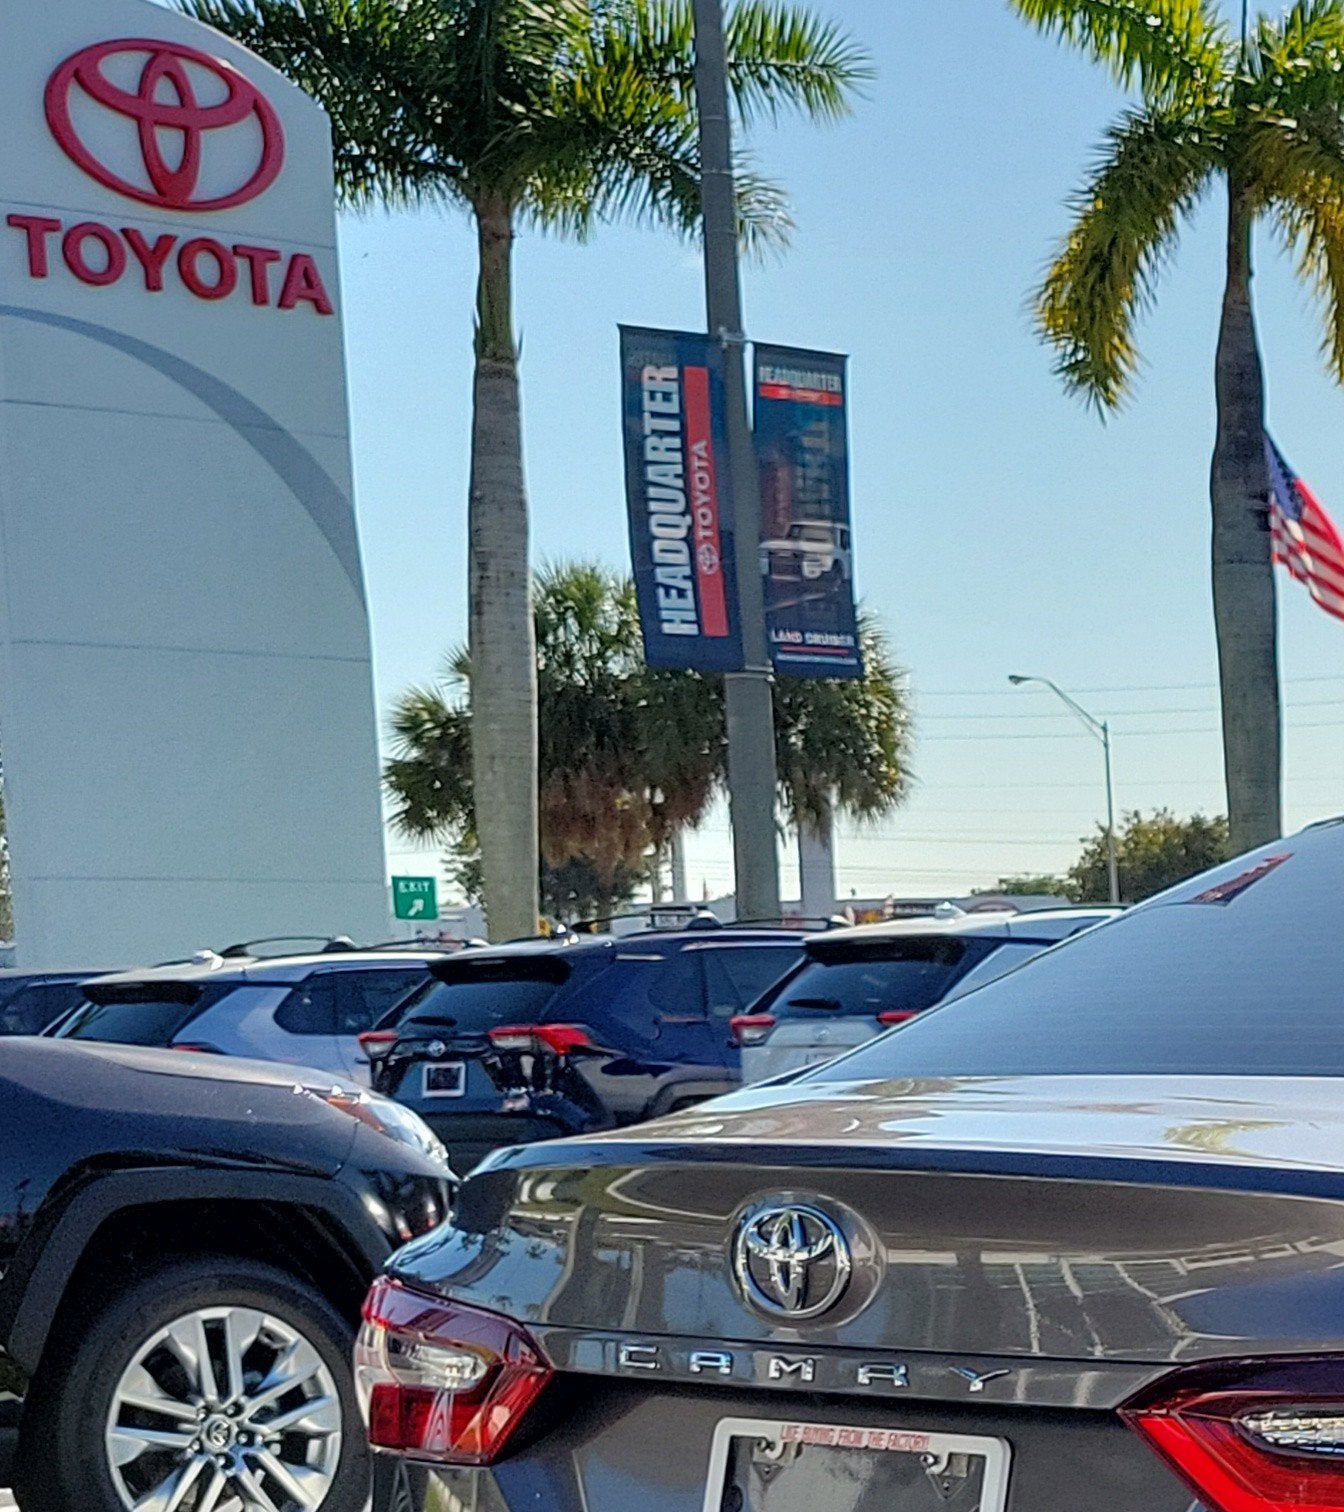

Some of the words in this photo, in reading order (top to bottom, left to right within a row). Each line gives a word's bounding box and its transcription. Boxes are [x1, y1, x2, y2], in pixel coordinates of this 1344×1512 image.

[7, 213, 334, 315] TOYOTA
[640, 364, 700, 636] HEADQUARTER
[690, 440, 719, 541] TOYOTA
[399, 880, 430, 893] EXIT
[618, 1343, 1010, 1392] CAMRY
